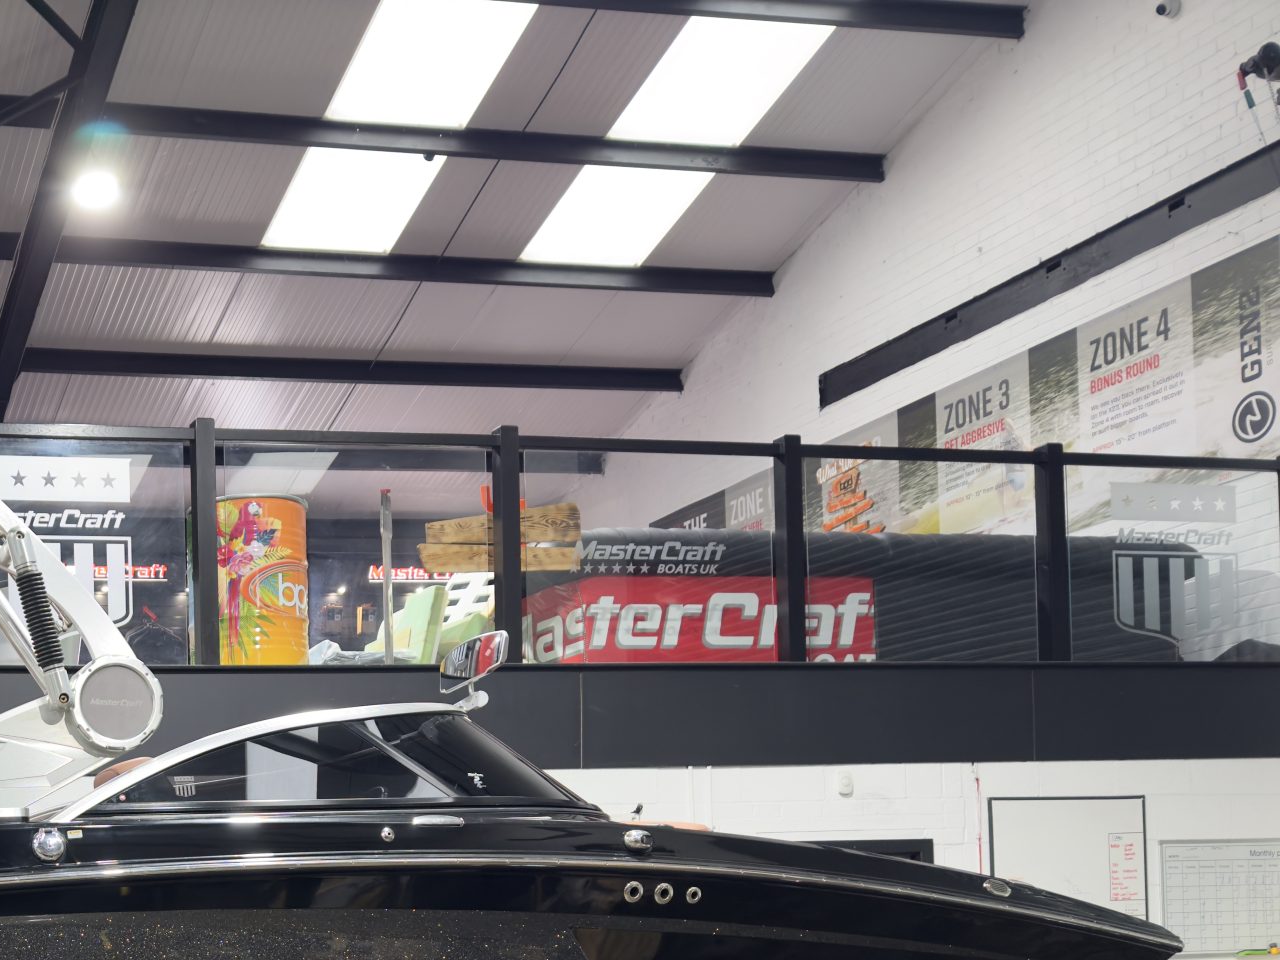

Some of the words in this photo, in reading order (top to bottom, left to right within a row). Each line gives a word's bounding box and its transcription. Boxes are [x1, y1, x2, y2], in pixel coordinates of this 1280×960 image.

[1089, 316, 1149, 372] ZONE
[1156, 307, 1170, 341] 4
[1090, 369, 1123, 394] BONUS
[1126, 354, 1160, 380] ROUND
[944, 385, 993, 434] ZONE
[999, 379, 1010, 410] 3
[961, 417, 1005, 447] AGGRESIVE
[729, 488, 765, 525] ZONE
[683, 513, 708, 530] THE
[1116, 528, 1233, 545] MasterCraft
[575, 540, 726, 561] MasterCraft
[657, 563, 698, 574] BOATS
[699, 563, 719, 574] UK
[1249, 849, 1275, 858] Monthly
